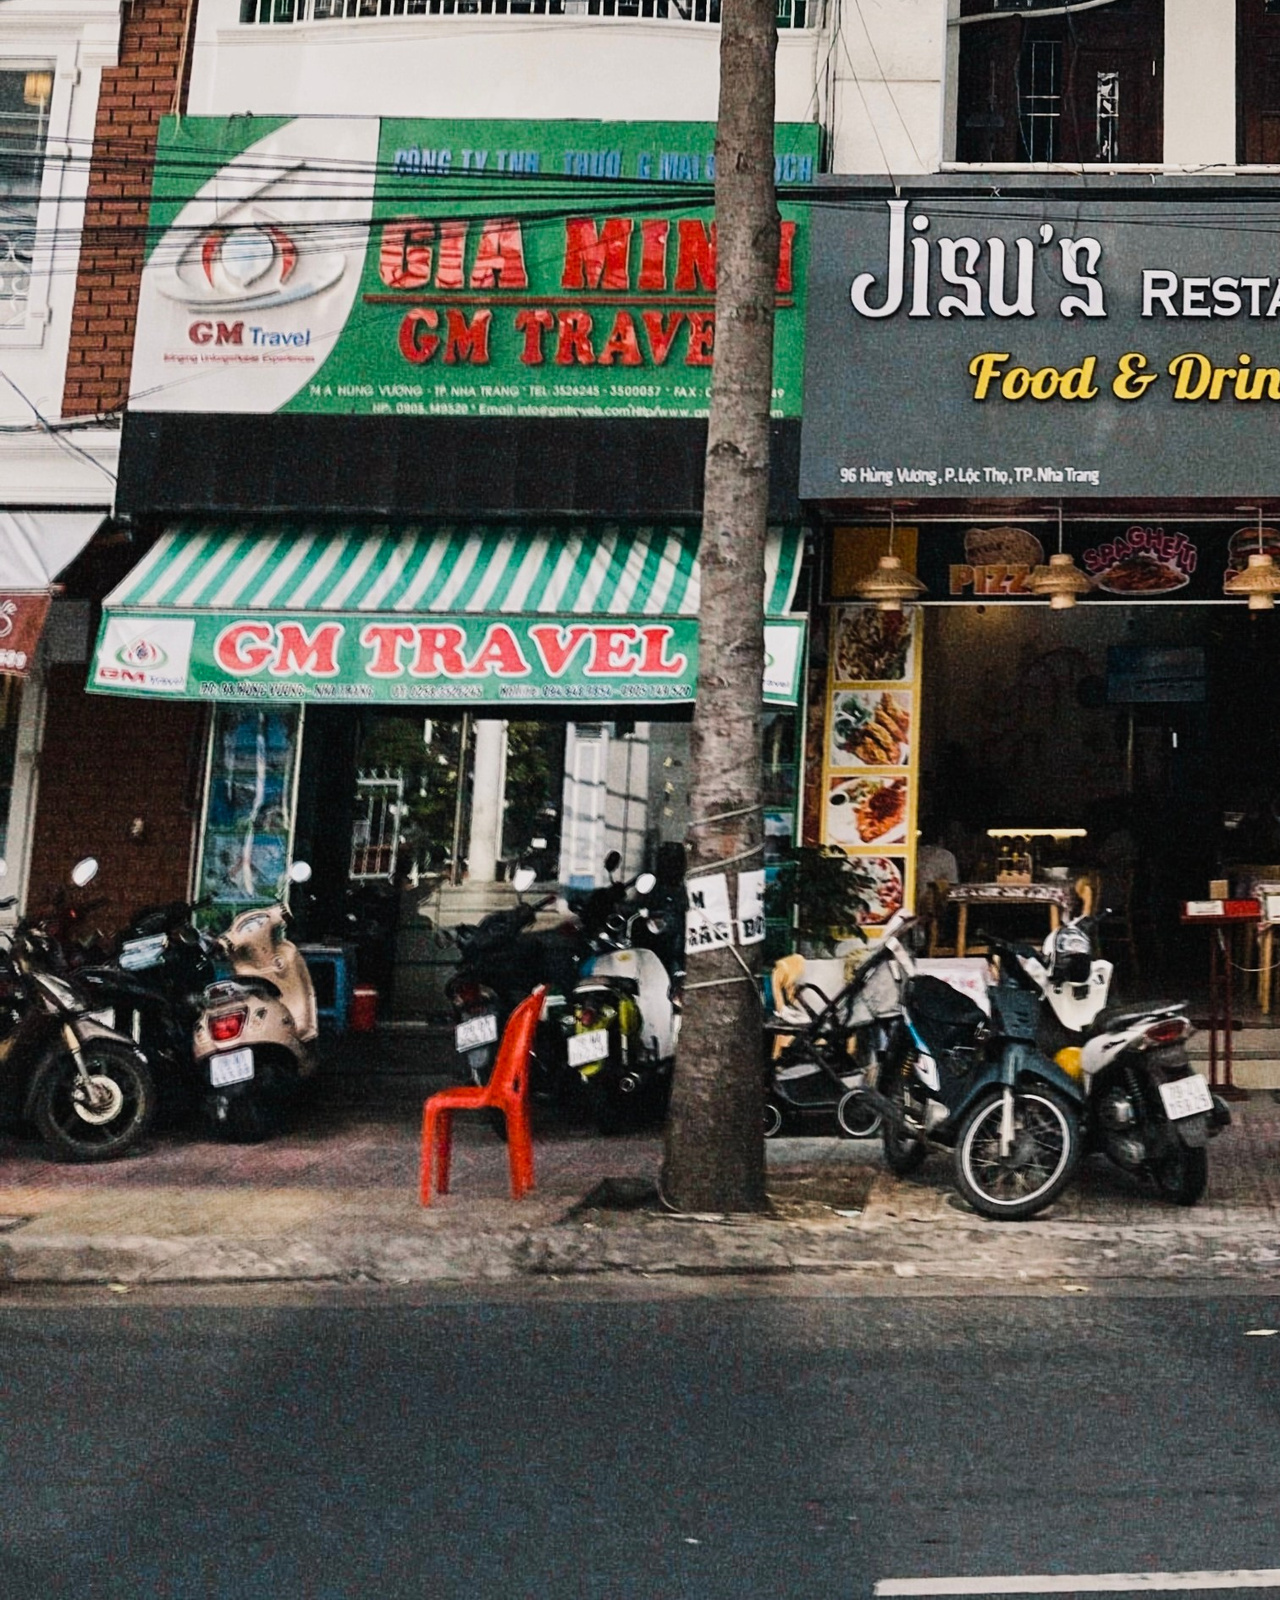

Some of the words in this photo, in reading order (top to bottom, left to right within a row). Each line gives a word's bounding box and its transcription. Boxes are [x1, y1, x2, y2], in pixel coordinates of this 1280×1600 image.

[460, 150, 487, 176] TY
[379, 214, 528, 289] GIA
[850, 199, 1107, 318] Jisu's
[188, 320, 244, 346] GM
[249, 326, 311, 347] Travel
[398, 308, 492, 364] GM
[514, 308, 716, 365] TRAVE
[480, 385, 519, 397] TRANG
[968, 352, 1099, 401] Food
[1112, 353, 1158, 400] &
[840, 467, 857, 483] 96
[859, 466, 893, 486] Hùng
[1064, 467, 1100, 486] Trang
[1083, 526, 1197, 573] SPAGHETTI
[949, 564, 1041, 594] PIZZ
[212, 620, 346, 677] GM
[360, 621, 690, 678] TRAVEL
